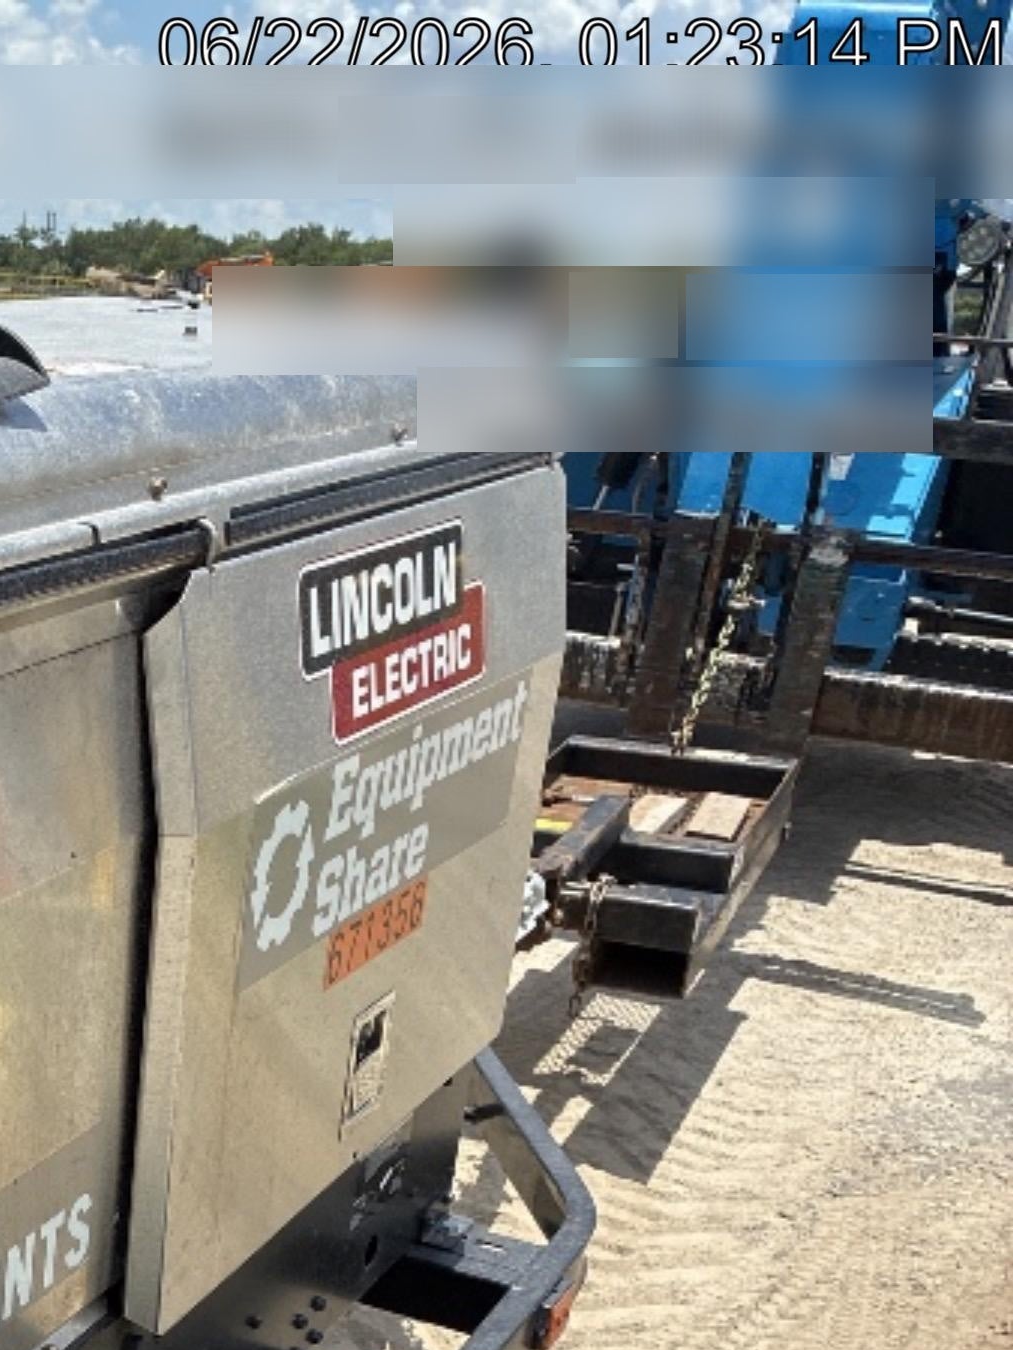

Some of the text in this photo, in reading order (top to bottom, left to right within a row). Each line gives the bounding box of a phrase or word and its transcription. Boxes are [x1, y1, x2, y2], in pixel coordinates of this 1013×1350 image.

[308, 541, 457, 658] LINCOLN
[351, 622, 472, 719] ELECTRIC
[323, 680, 528, 843] Equipment
[311, 822, 430, 938] Share
